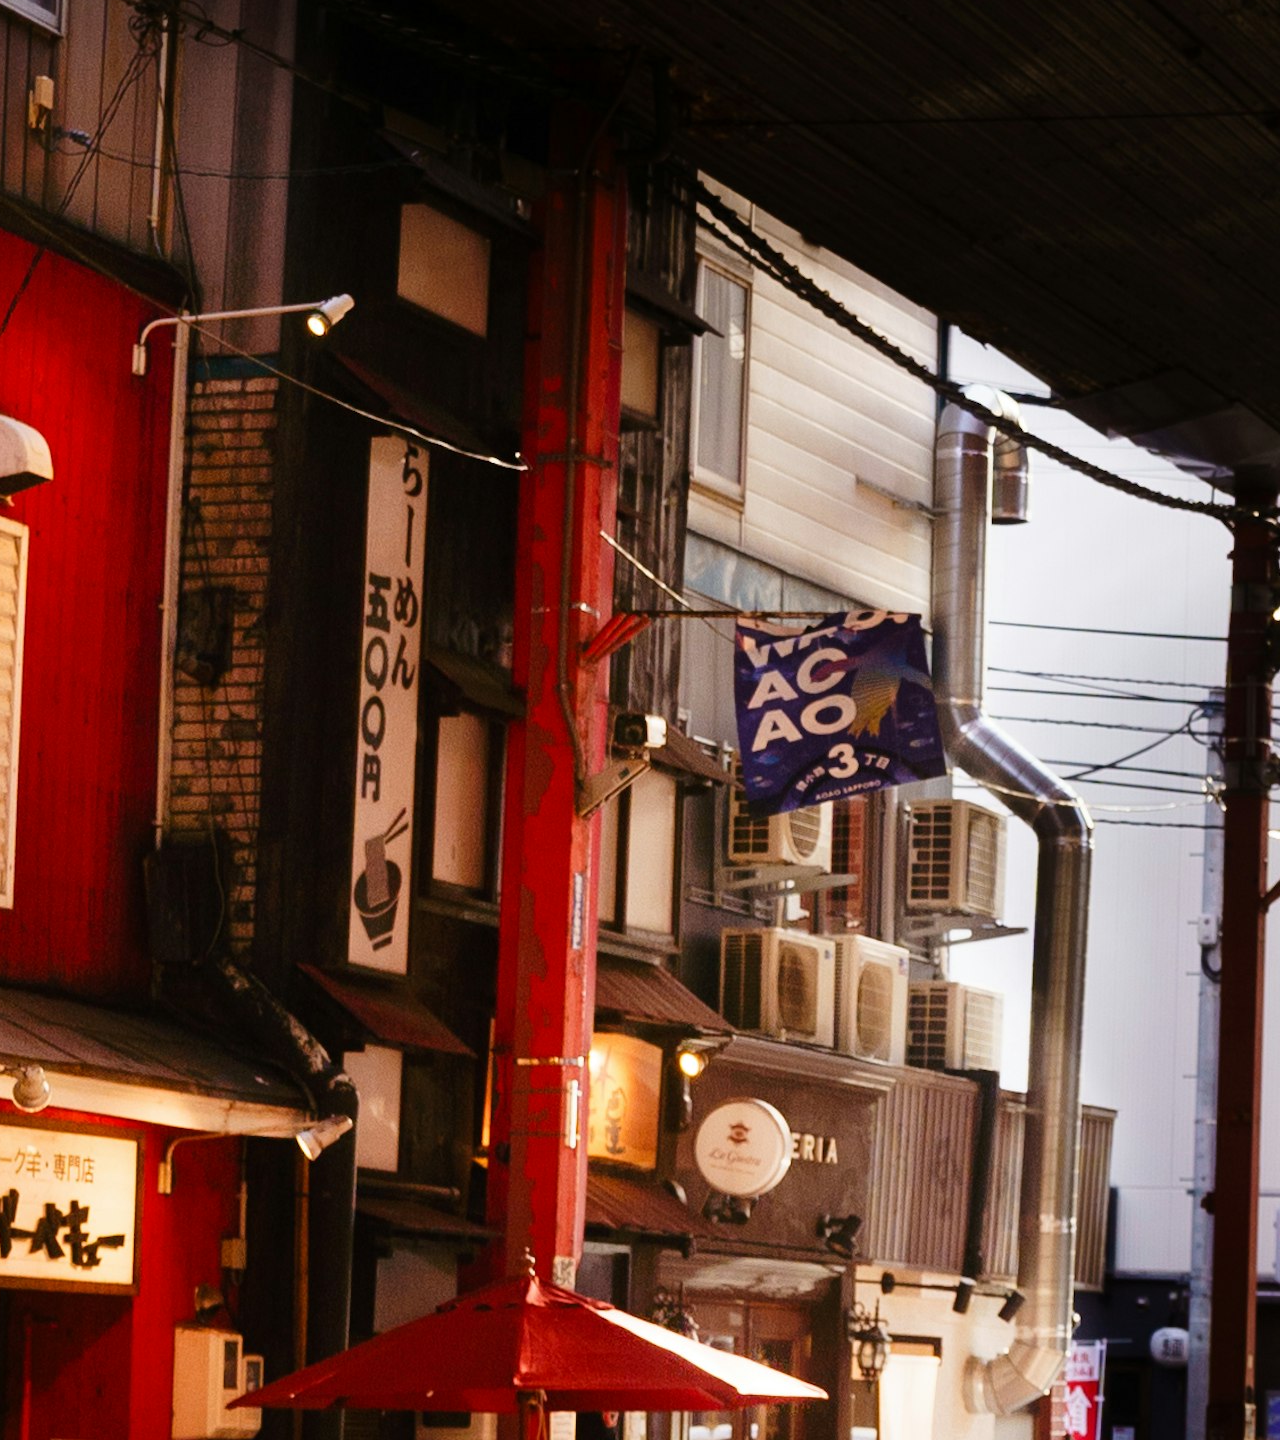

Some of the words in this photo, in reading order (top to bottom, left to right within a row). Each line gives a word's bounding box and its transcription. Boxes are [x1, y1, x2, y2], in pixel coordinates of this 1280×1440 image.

[391, 442, 423, 690] らーめん
[747, 647, 849, 710] AC
[751, 694, 857, 753] AO
[815, 788, 841, 801] AOAO
[843, 779, 882, 795] SAPPORO
[828, 743, 860, 779] 3
[864, 753, 891, 770] 丁目
